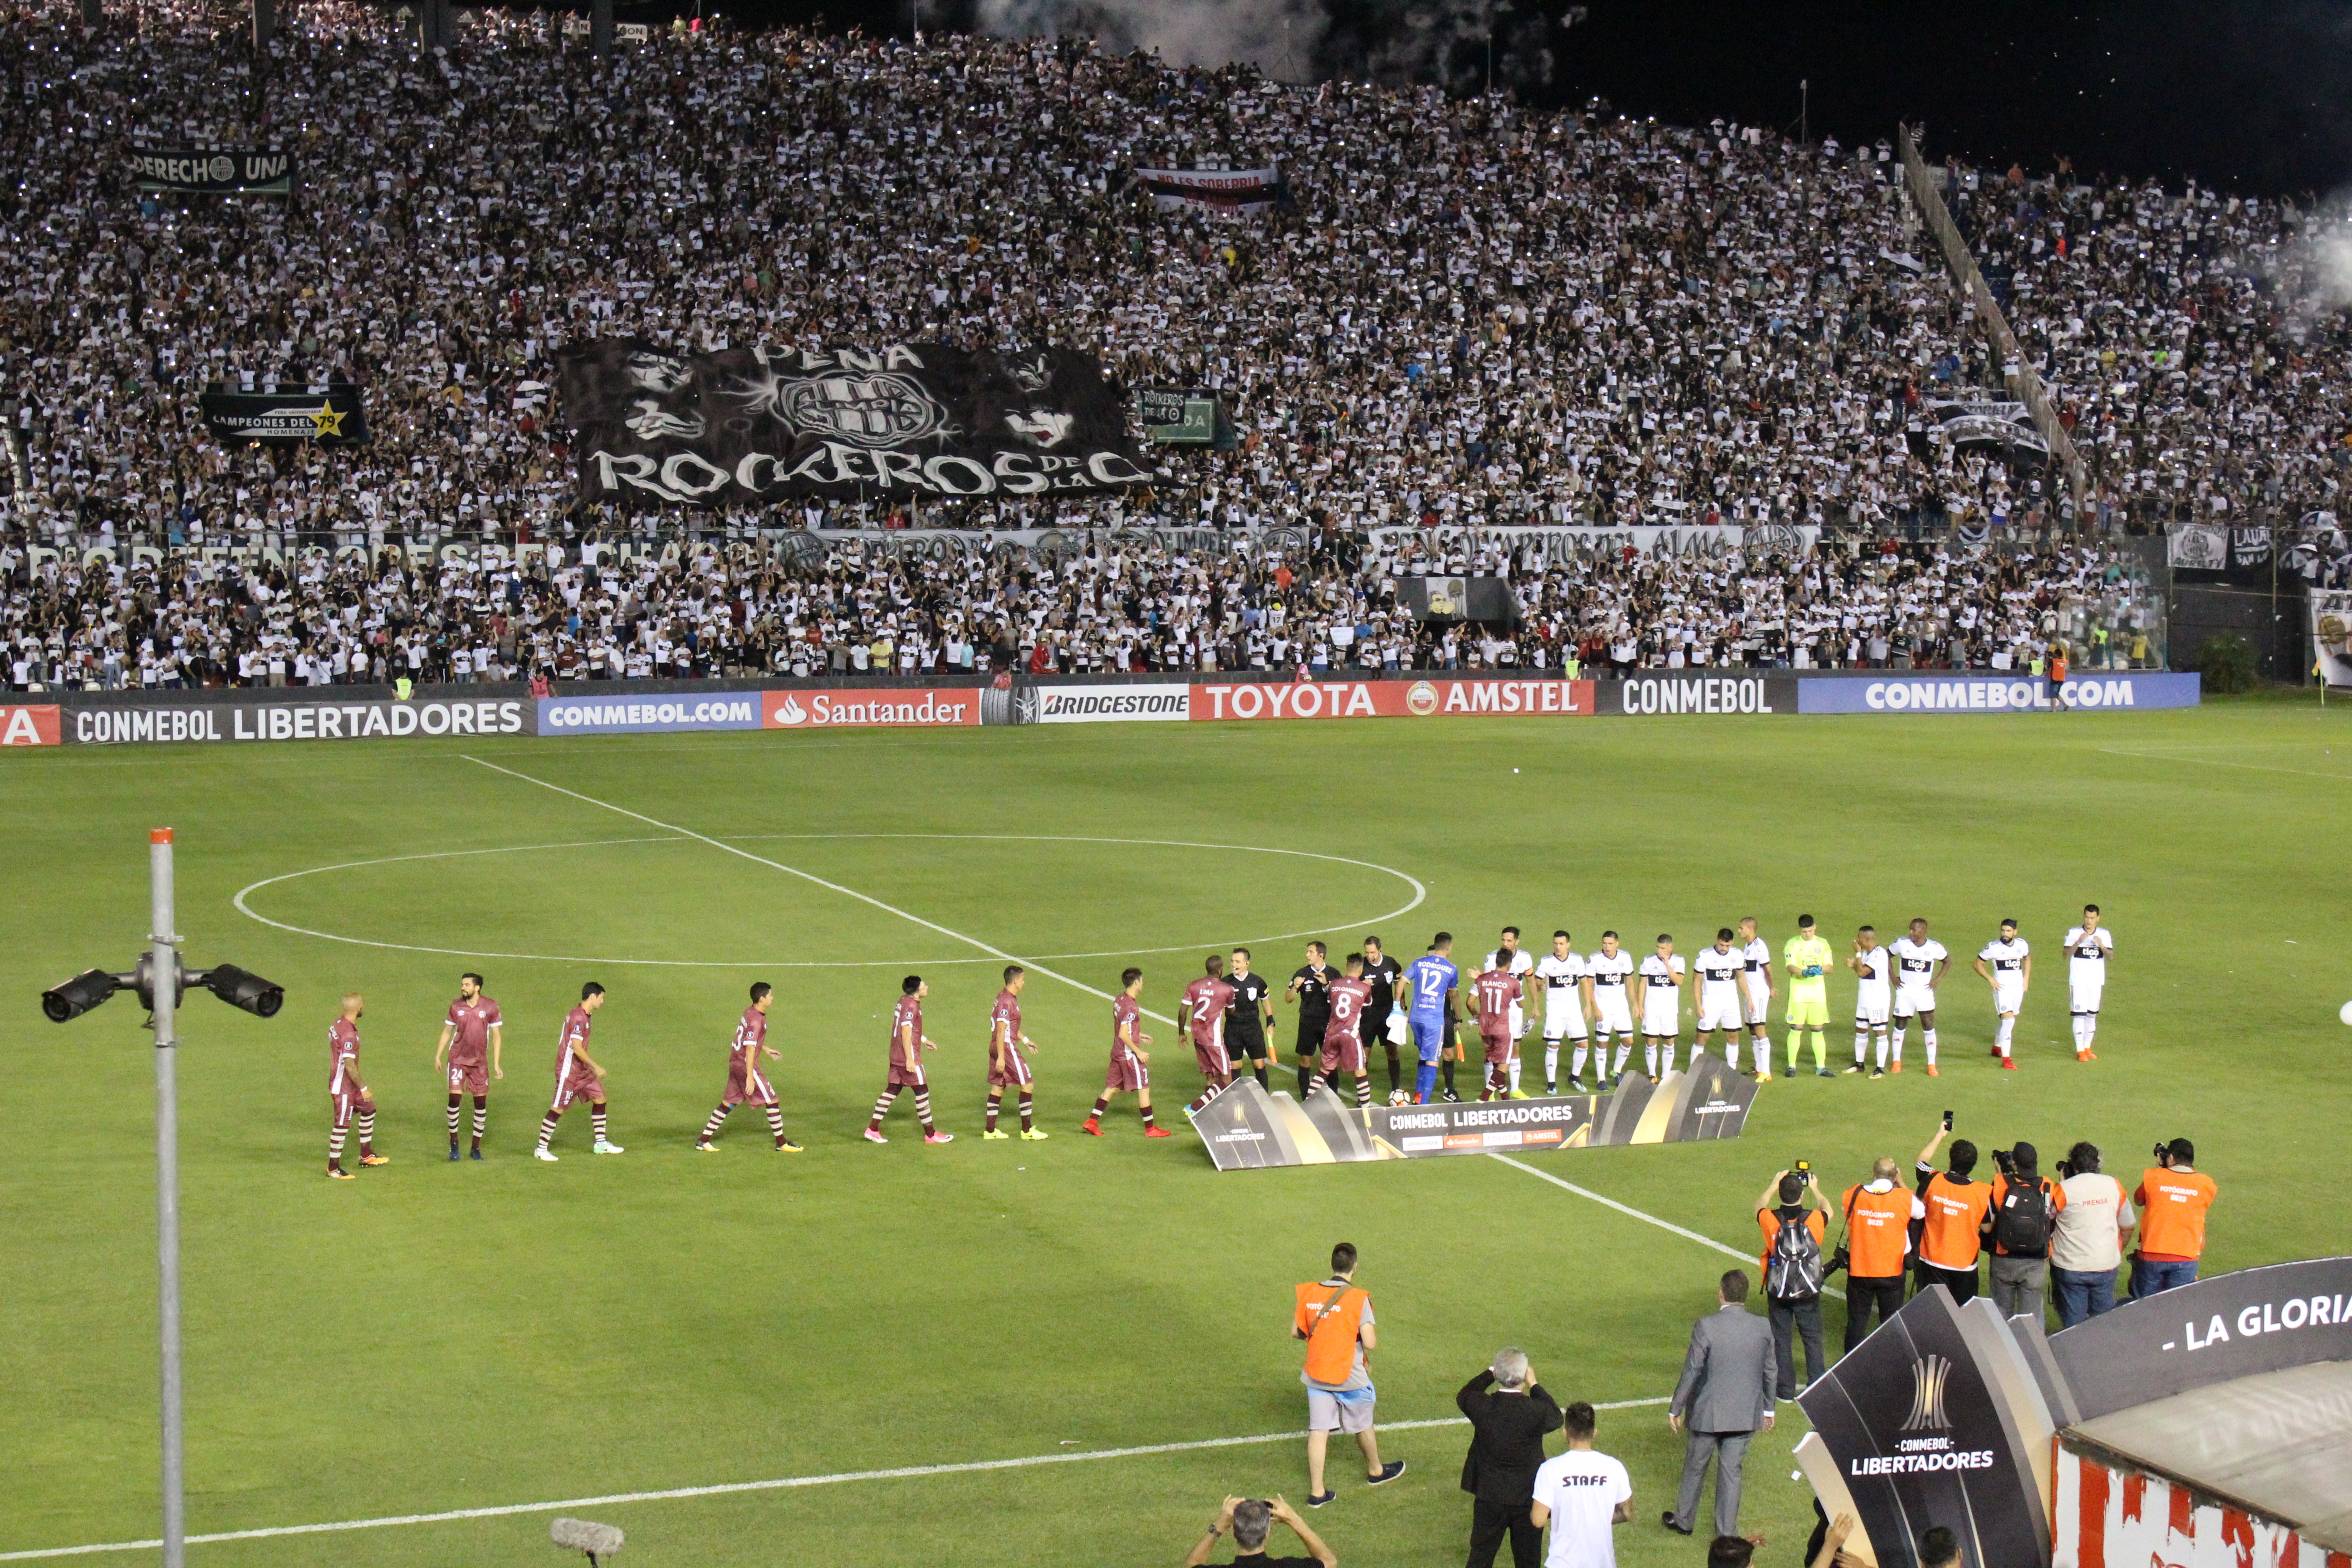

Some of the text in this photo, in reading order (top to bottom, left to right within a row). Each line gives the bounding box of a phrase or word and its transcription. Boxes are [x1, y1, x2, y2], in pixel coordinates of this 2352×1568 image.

[246, 155, 288, 180] UNA
[1143, 390, 1184, 407] ROCKEROS
[1144, 407, 1155, 416] DE
[213, 415, 335, 428] CAMPEONES DEL 79
[588, 441, 1049, 503] ROCKEROS
[1039, 456, 1083, 472] DE
[1054, 472, 1096, 488] LA
[1205, 684, 1376, 718] TOYOTA
[1444, 682, 1578, 712] AMSTEL
[1623, 678, 1773, 714] CONMEBOL
[1866, 680, 2134, 709] CONMEBOL.COM
[813, 692, 965, 725] Santander
[1043, 695, 1189, 715] BRIDGESTONE
[77, 702, 522, 742] CONMEBOL LIBERTADORES
[549, 702, 752, 726] CONMEBOL.COM
[1418, 961, 1453, 974] RODRIGUEZ
[1421, 968, 1442, 997] 12
[1481, 980, 1508, 989] BLANCO
[1331, 986, 1364, 997] COLOMBINO
[1194, 996, 1211, 1021] 2
[1335, 993, 1352, 1019] 8
[1485, 987, 1503, 1014] 11
[1872, 1009, 1879, 1018] 19
[451, 1068, 463, 1080] 24
[1389, 1105, 1573, 1130] CONMEBOL LIBERTADORES
[1695, 1104, 1740, 1114] LIBERTADORES
[1215, 1132, 1265, 1142] LIBERTADORES
[2160, 1186, 2198, 1196] FOTÓGRAFO
[1933, 1195, 1968, 1210] FOTÓGRAFO
[2082, 1198, 2108, 1207] PRENSA
[1857, 1209, 1895, 1218] FOTÓGRAFO
[2185, 1314, 2230, 1351] LA
[1900, 1437, 1950, 1452] CONMEBOL
[1851, 1450, 1994, 1475] LIBERTADORES
[1562, 1475, 1607, 1487] STAFF
